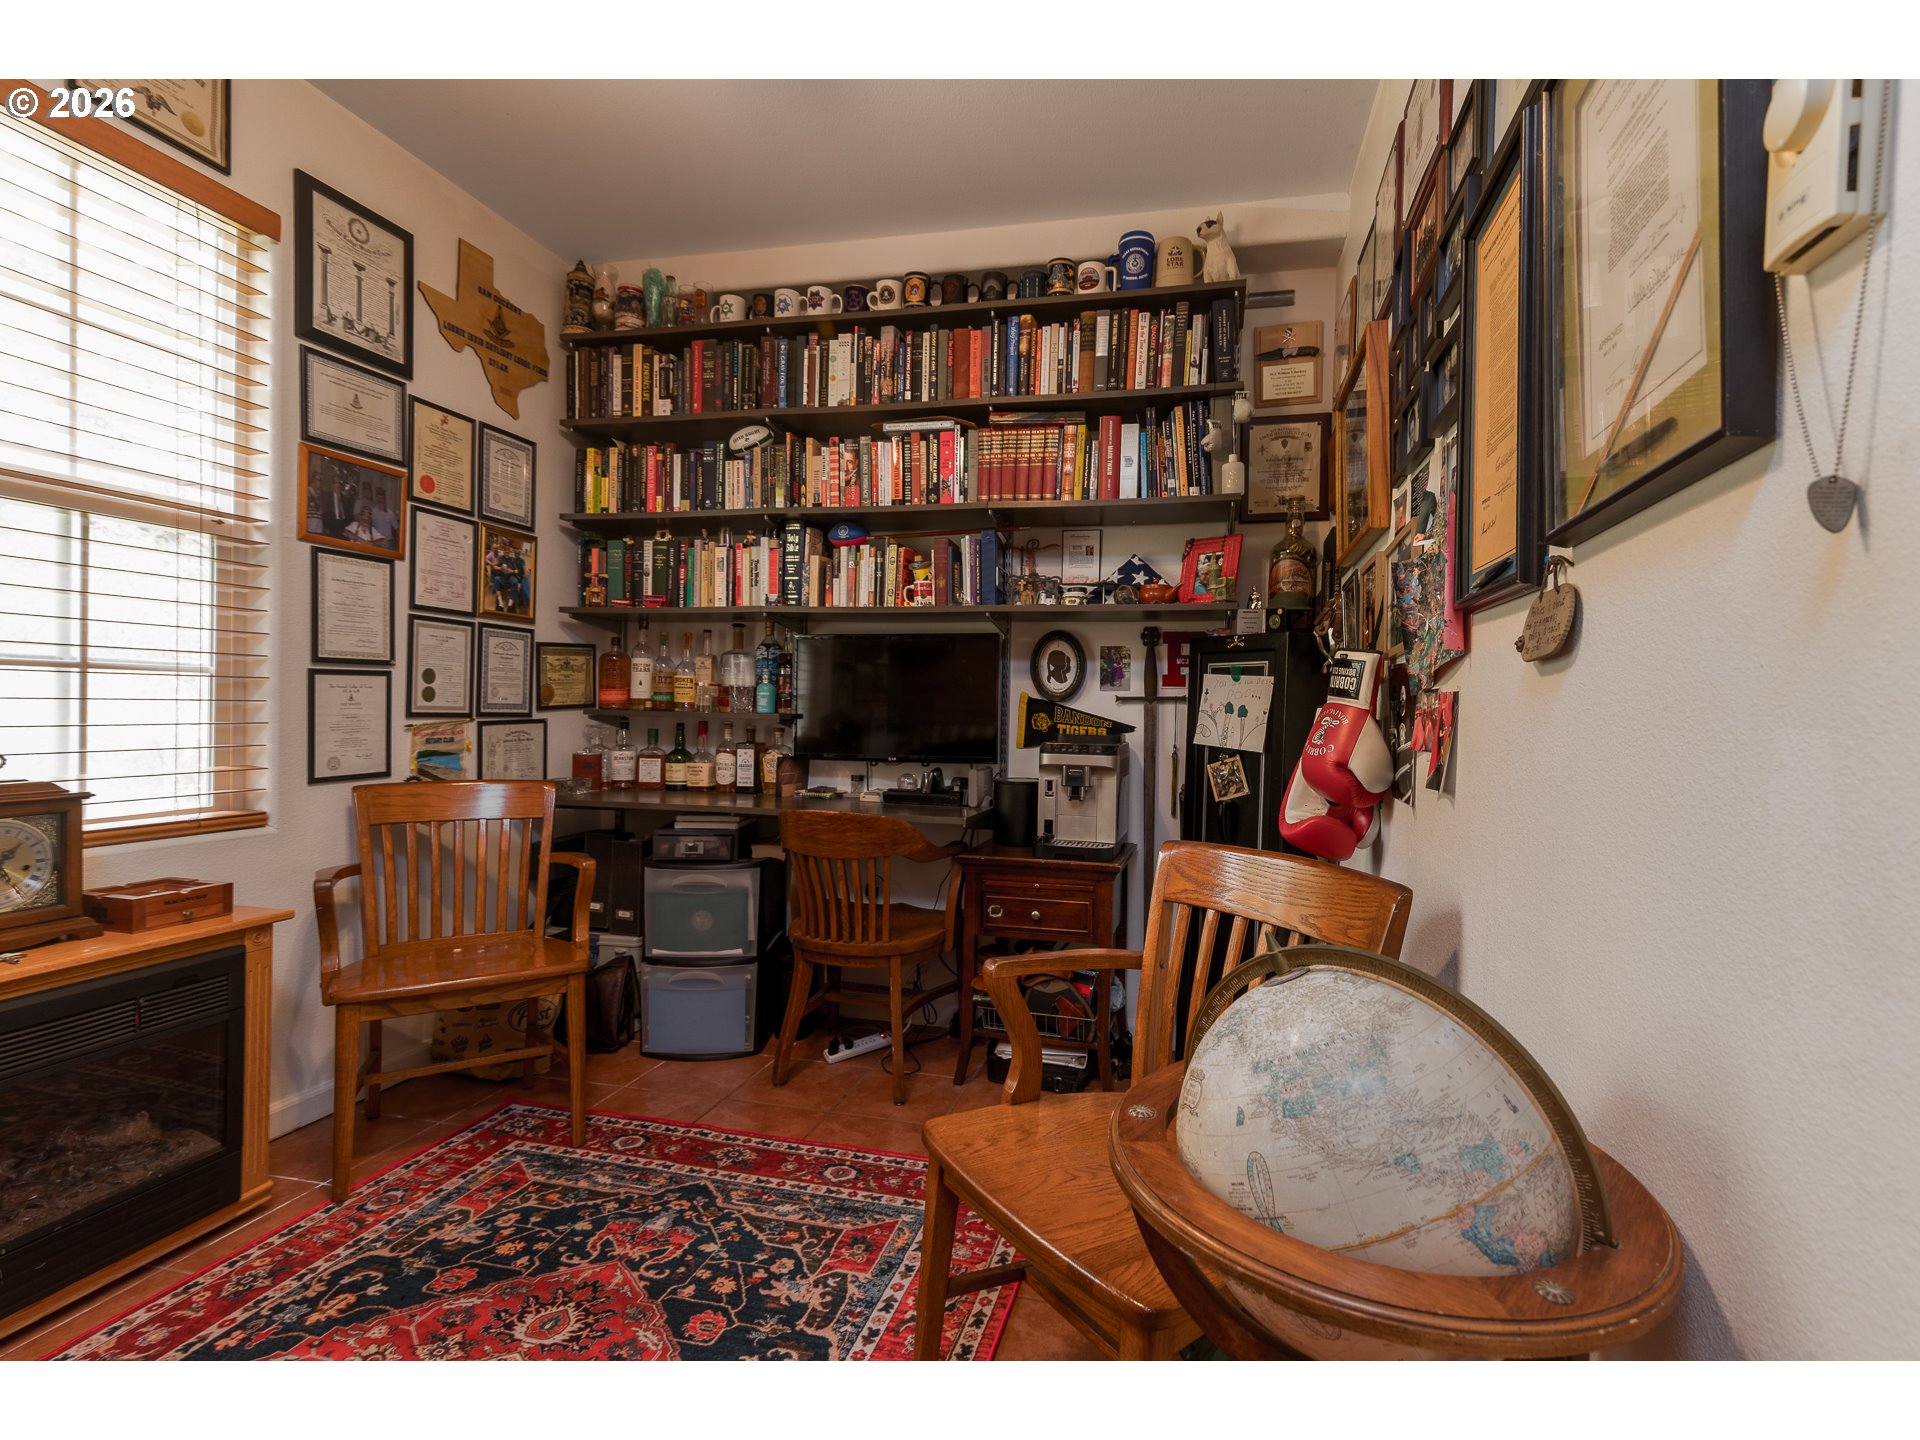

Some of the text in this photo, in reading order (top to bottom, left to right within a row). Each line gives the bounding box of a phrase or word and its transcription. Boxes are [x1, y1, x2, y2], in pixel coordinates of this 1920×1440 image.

[786, 533, 799, 543] Holy
[1054, 706, 1113, 728] BANDON
[1057, 723, 1107, 737] TIGERS
[425, 736, 442, 744] ROTARY
